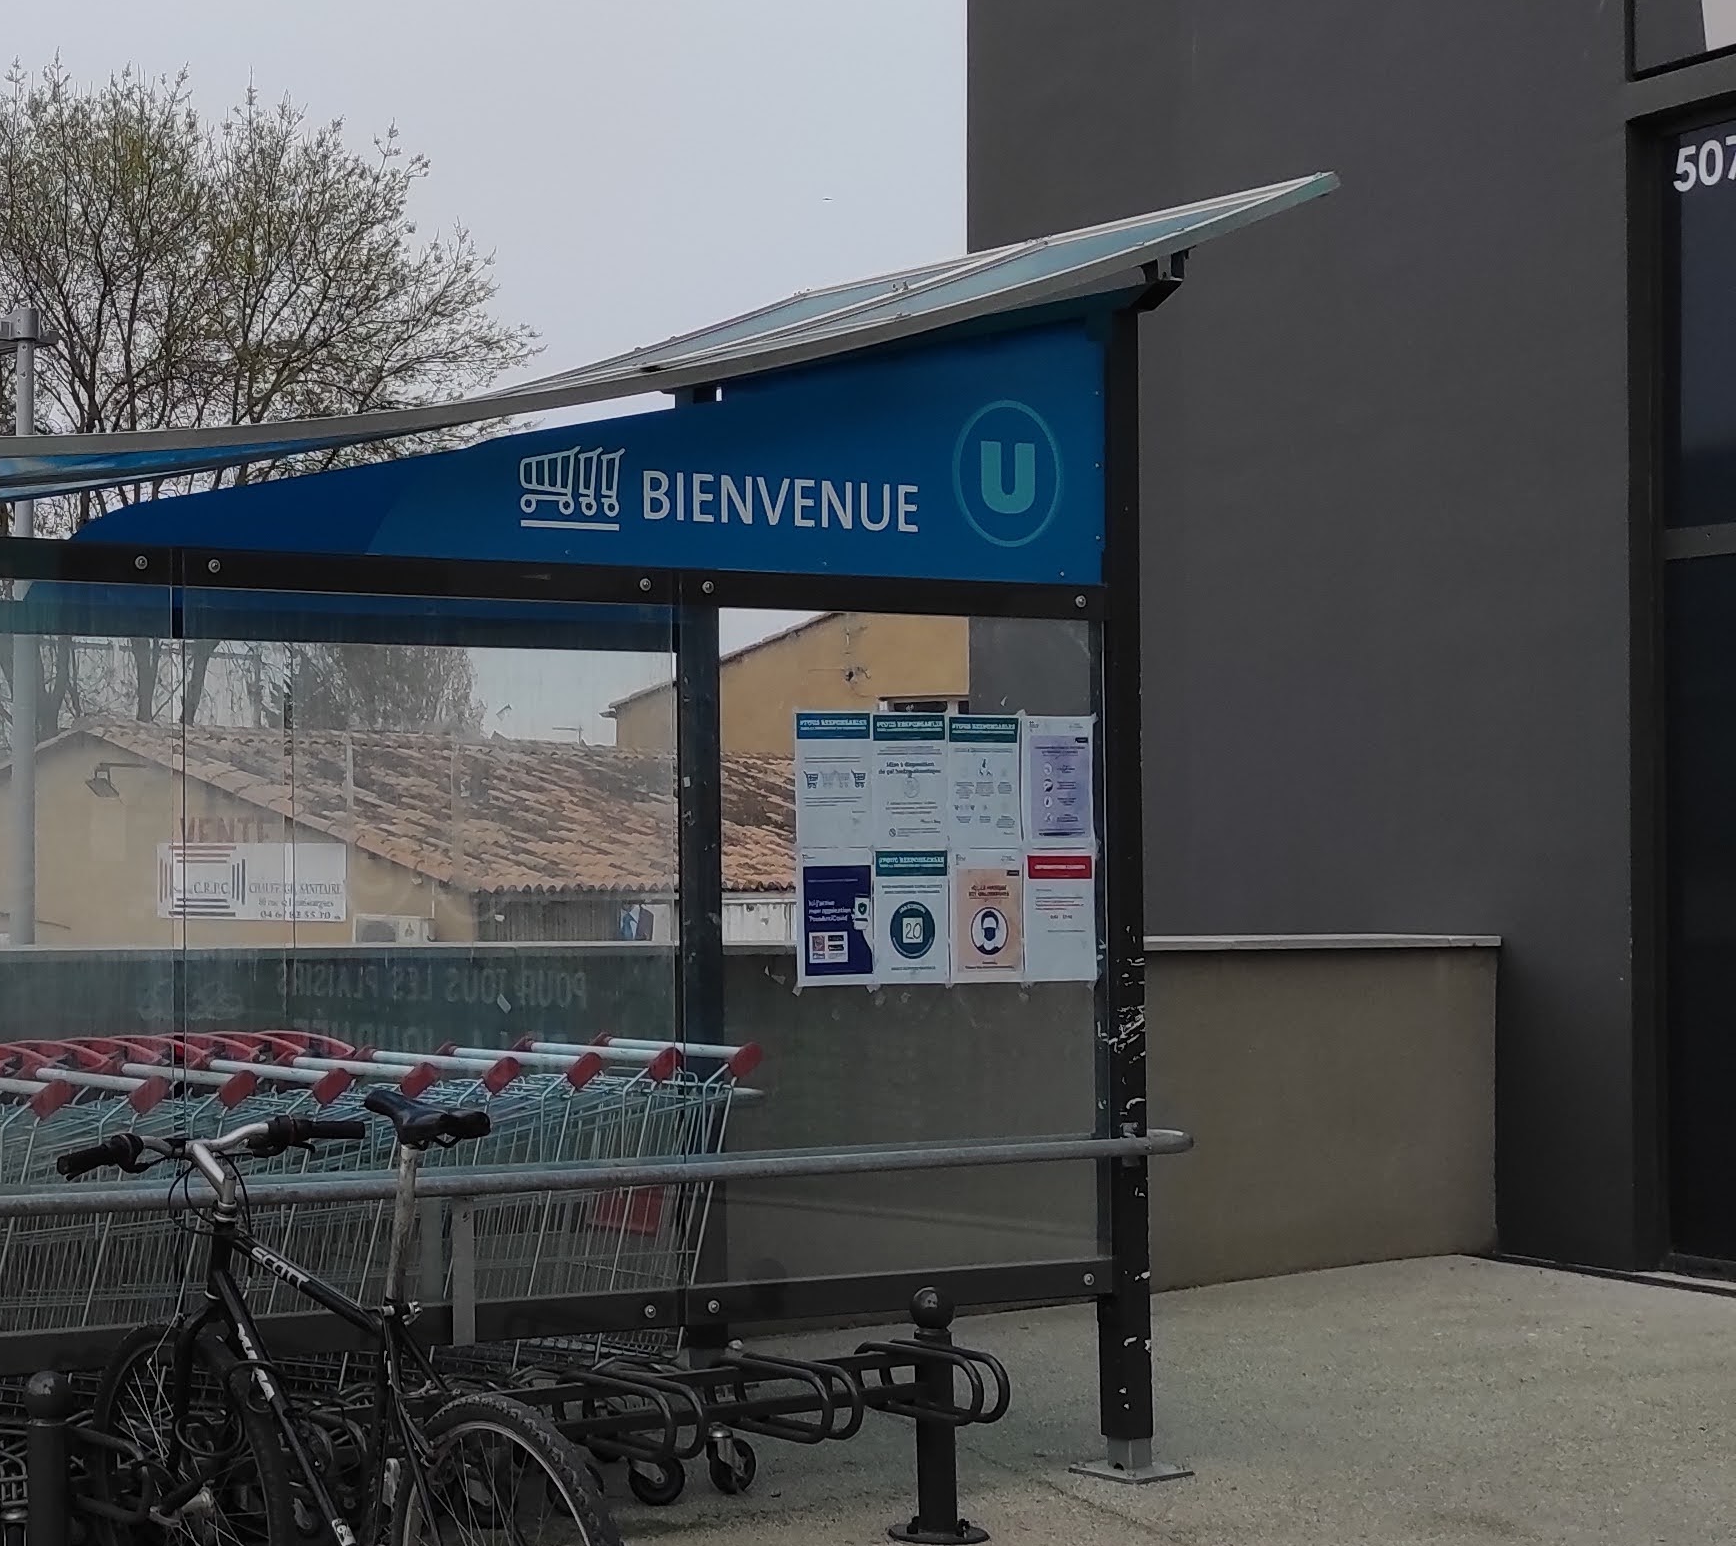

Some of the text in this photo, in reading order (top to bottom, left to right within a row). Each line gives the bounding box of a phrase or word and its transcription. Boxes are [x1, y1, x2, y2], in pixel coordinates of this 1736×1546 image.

[642, 469, 919, 533] BIENVENUE
[980, 440, 1035, 514] U
[905, 922, 922, 940] 20
[251, 1246, 311, 1291] SCOTT
